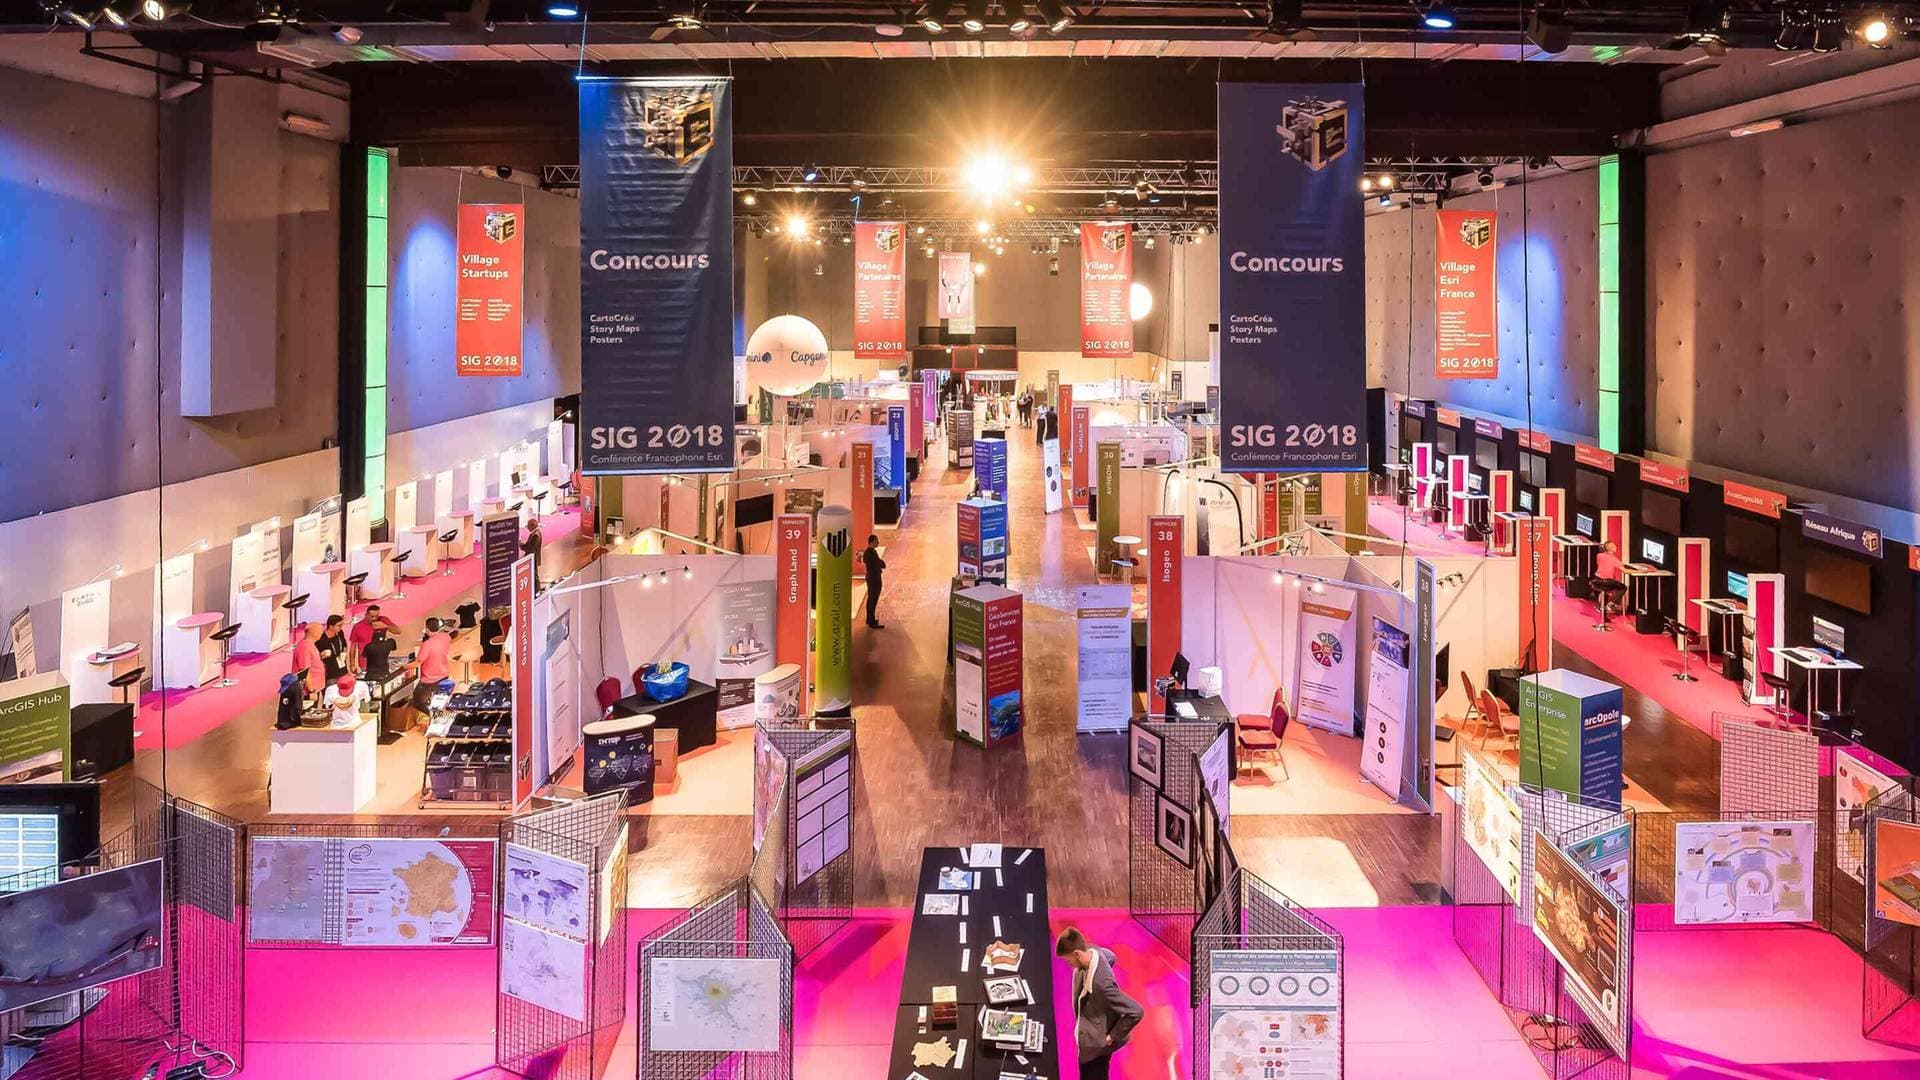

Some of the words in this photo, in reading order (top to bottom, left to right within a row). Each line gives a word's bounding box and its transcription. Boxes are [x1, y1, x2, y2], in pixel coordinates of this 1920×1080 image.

[462, 254, 499, 267] Village
[590, 250, 710, 270] Concours
[1230, 251, 1344, 272] Concours
[858, 261, 887, 272] Village
[1085, 261, 1114, 271] Village
[1440, 262, 1475, 273] Village
[462, 268, 509, 280] Startups
[858, 273, 902, 281] Partenaires
[1440, 275, 1459, 285] Esri
[1440, 289, 1475, 299] France
[590, 313, 635, 323] CartoCréa
[1230, 314, 1273, 323] CartoCréa
[590, 324, 614, 334] Story
[616, 324, 640, 334] Maps
[1230, 325, 1253, 335] Story
[1255, 325, 1278, 335] Maps
[590, 335, 623, 344] Posters
[1085, 340, 1101, 349] SIG
[1230, 335, 1262, 344] Posters
[858, 342, 874, 350] SIG
[461, 355, 480, 366] SIG
[1440, 357, 1459, 368] SIG
[590, 426, 638, 449] SIG
[1231, 425, 1276, 447] SIG
[590, 453, 643, 465] Conférence
[646, 452, 705, 465] Francophone
[706, 452, 724, 462] Esri
[1103, 451, 1114, 459] 30
[1231, 452, 1281, 462] Conférence
[1283, 452, 1340, 463] Francophone
[1341, 451, 1357, 461] Esri
[786, 530, 801, 540] 39
[1805, 519, 1829, 533] Réseau
[1830, 525, 1856, 541] Afrique
[1158, 531, 1174, 541] 38
[789, 548, 798, 572] Land
[1162, 550, 1172, 583] Isogeo
[519, 576, 529, 591] 39
[789, 573, 799, 604] Graph
[39, 693, 62, 707] Hub
[1584, 709, 1620, 726] arcOpole
